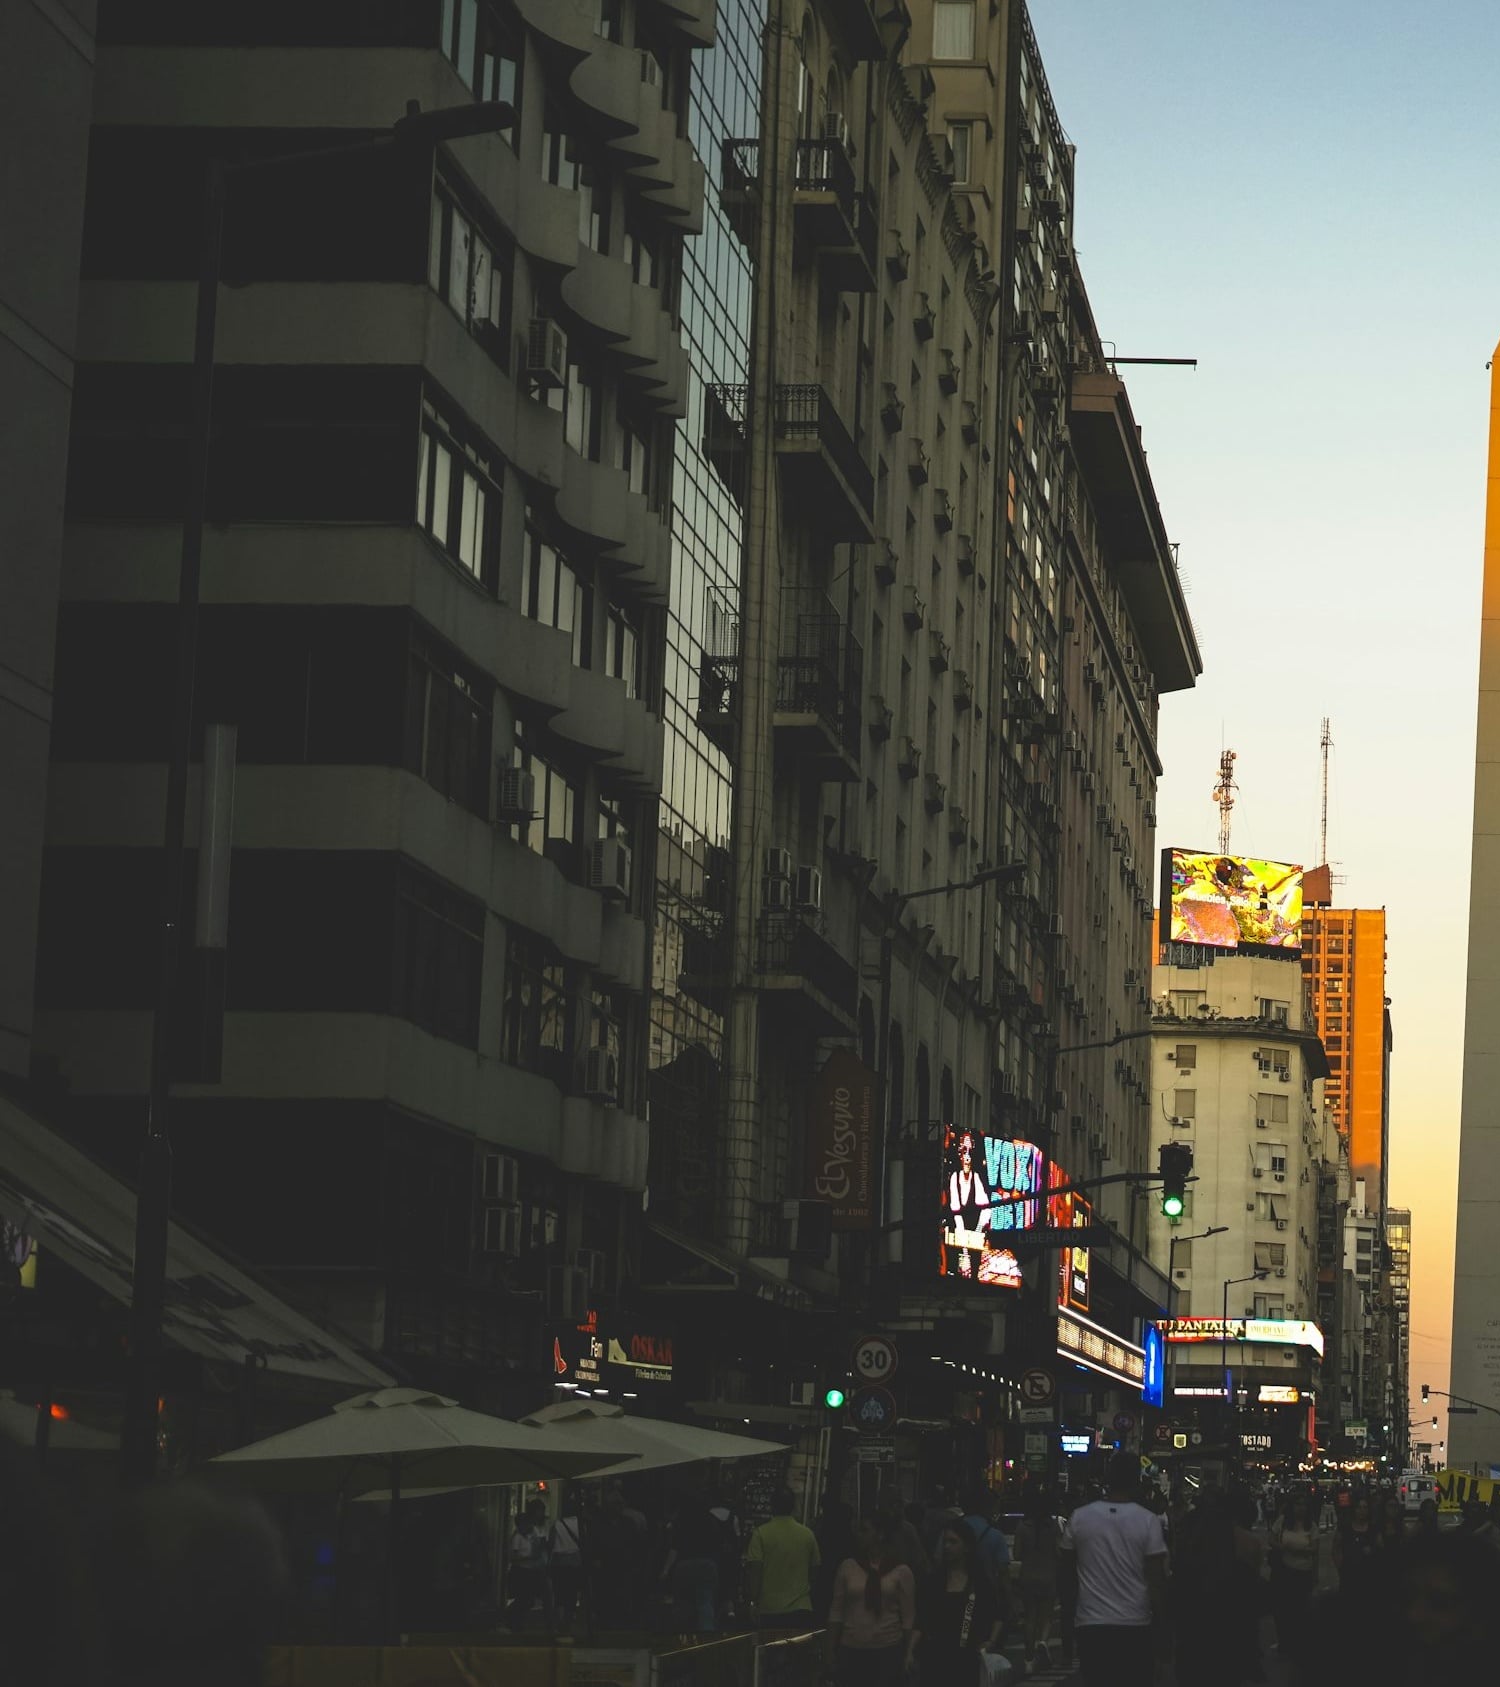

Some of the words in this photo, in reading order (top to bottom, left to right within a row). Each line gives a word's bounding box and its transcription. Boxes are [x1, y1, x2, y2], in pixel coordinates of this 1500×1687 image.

[823, 1087, 858, 1176] Vesuvio
[1018, 1231, 1080, 1244] LIBERTAD
[861, 1350, 887, 1369] 30
